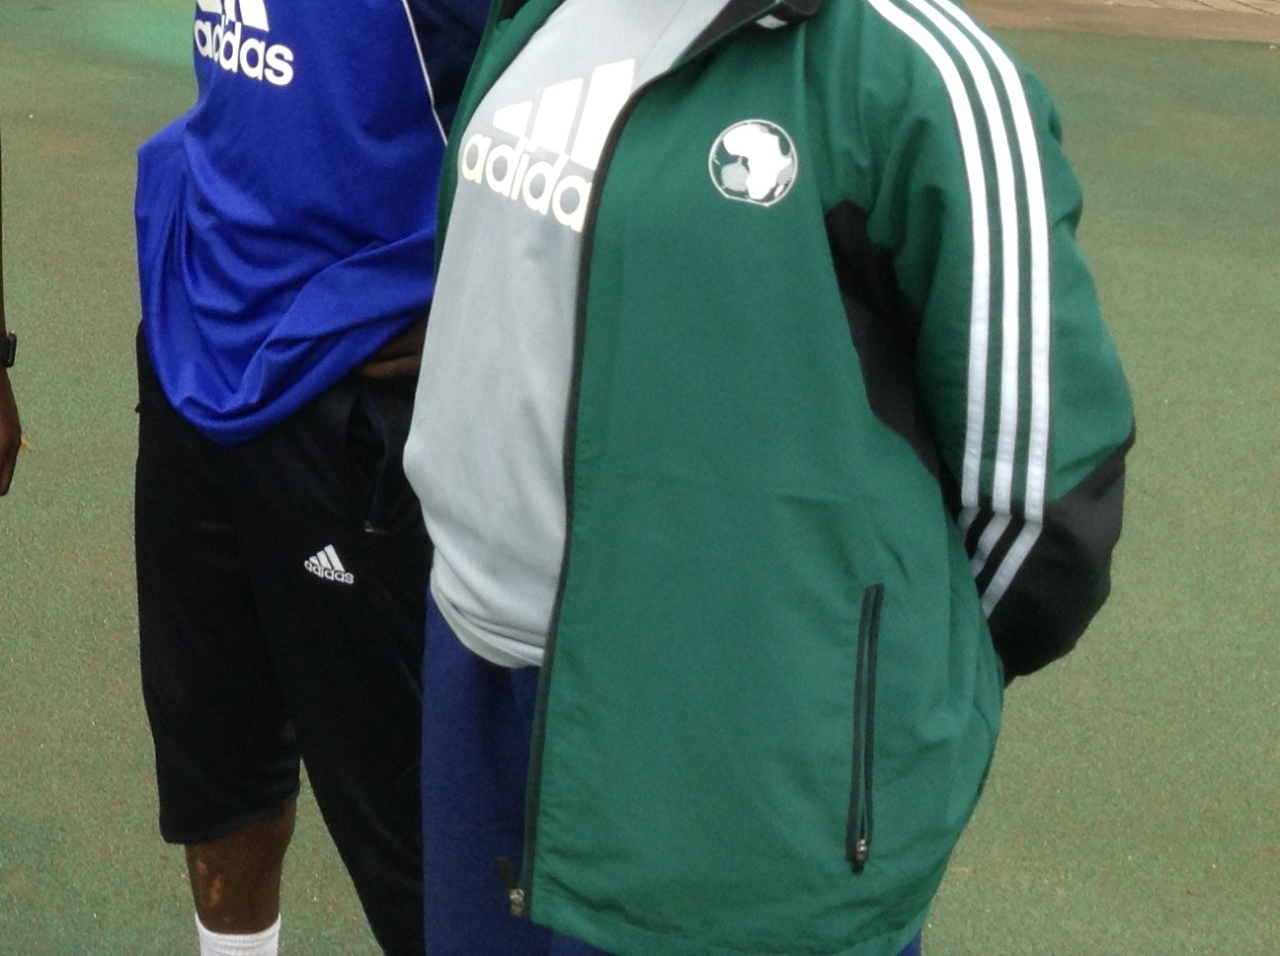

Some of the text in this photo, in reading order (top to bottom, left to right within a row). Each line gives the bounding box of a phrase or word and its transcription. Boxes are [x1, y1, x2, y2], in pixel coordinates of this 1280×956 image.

[194, 13, 294, 86] addas
[461, 132, 593, 234] adida
[303, 560, 355, 585] adidas
